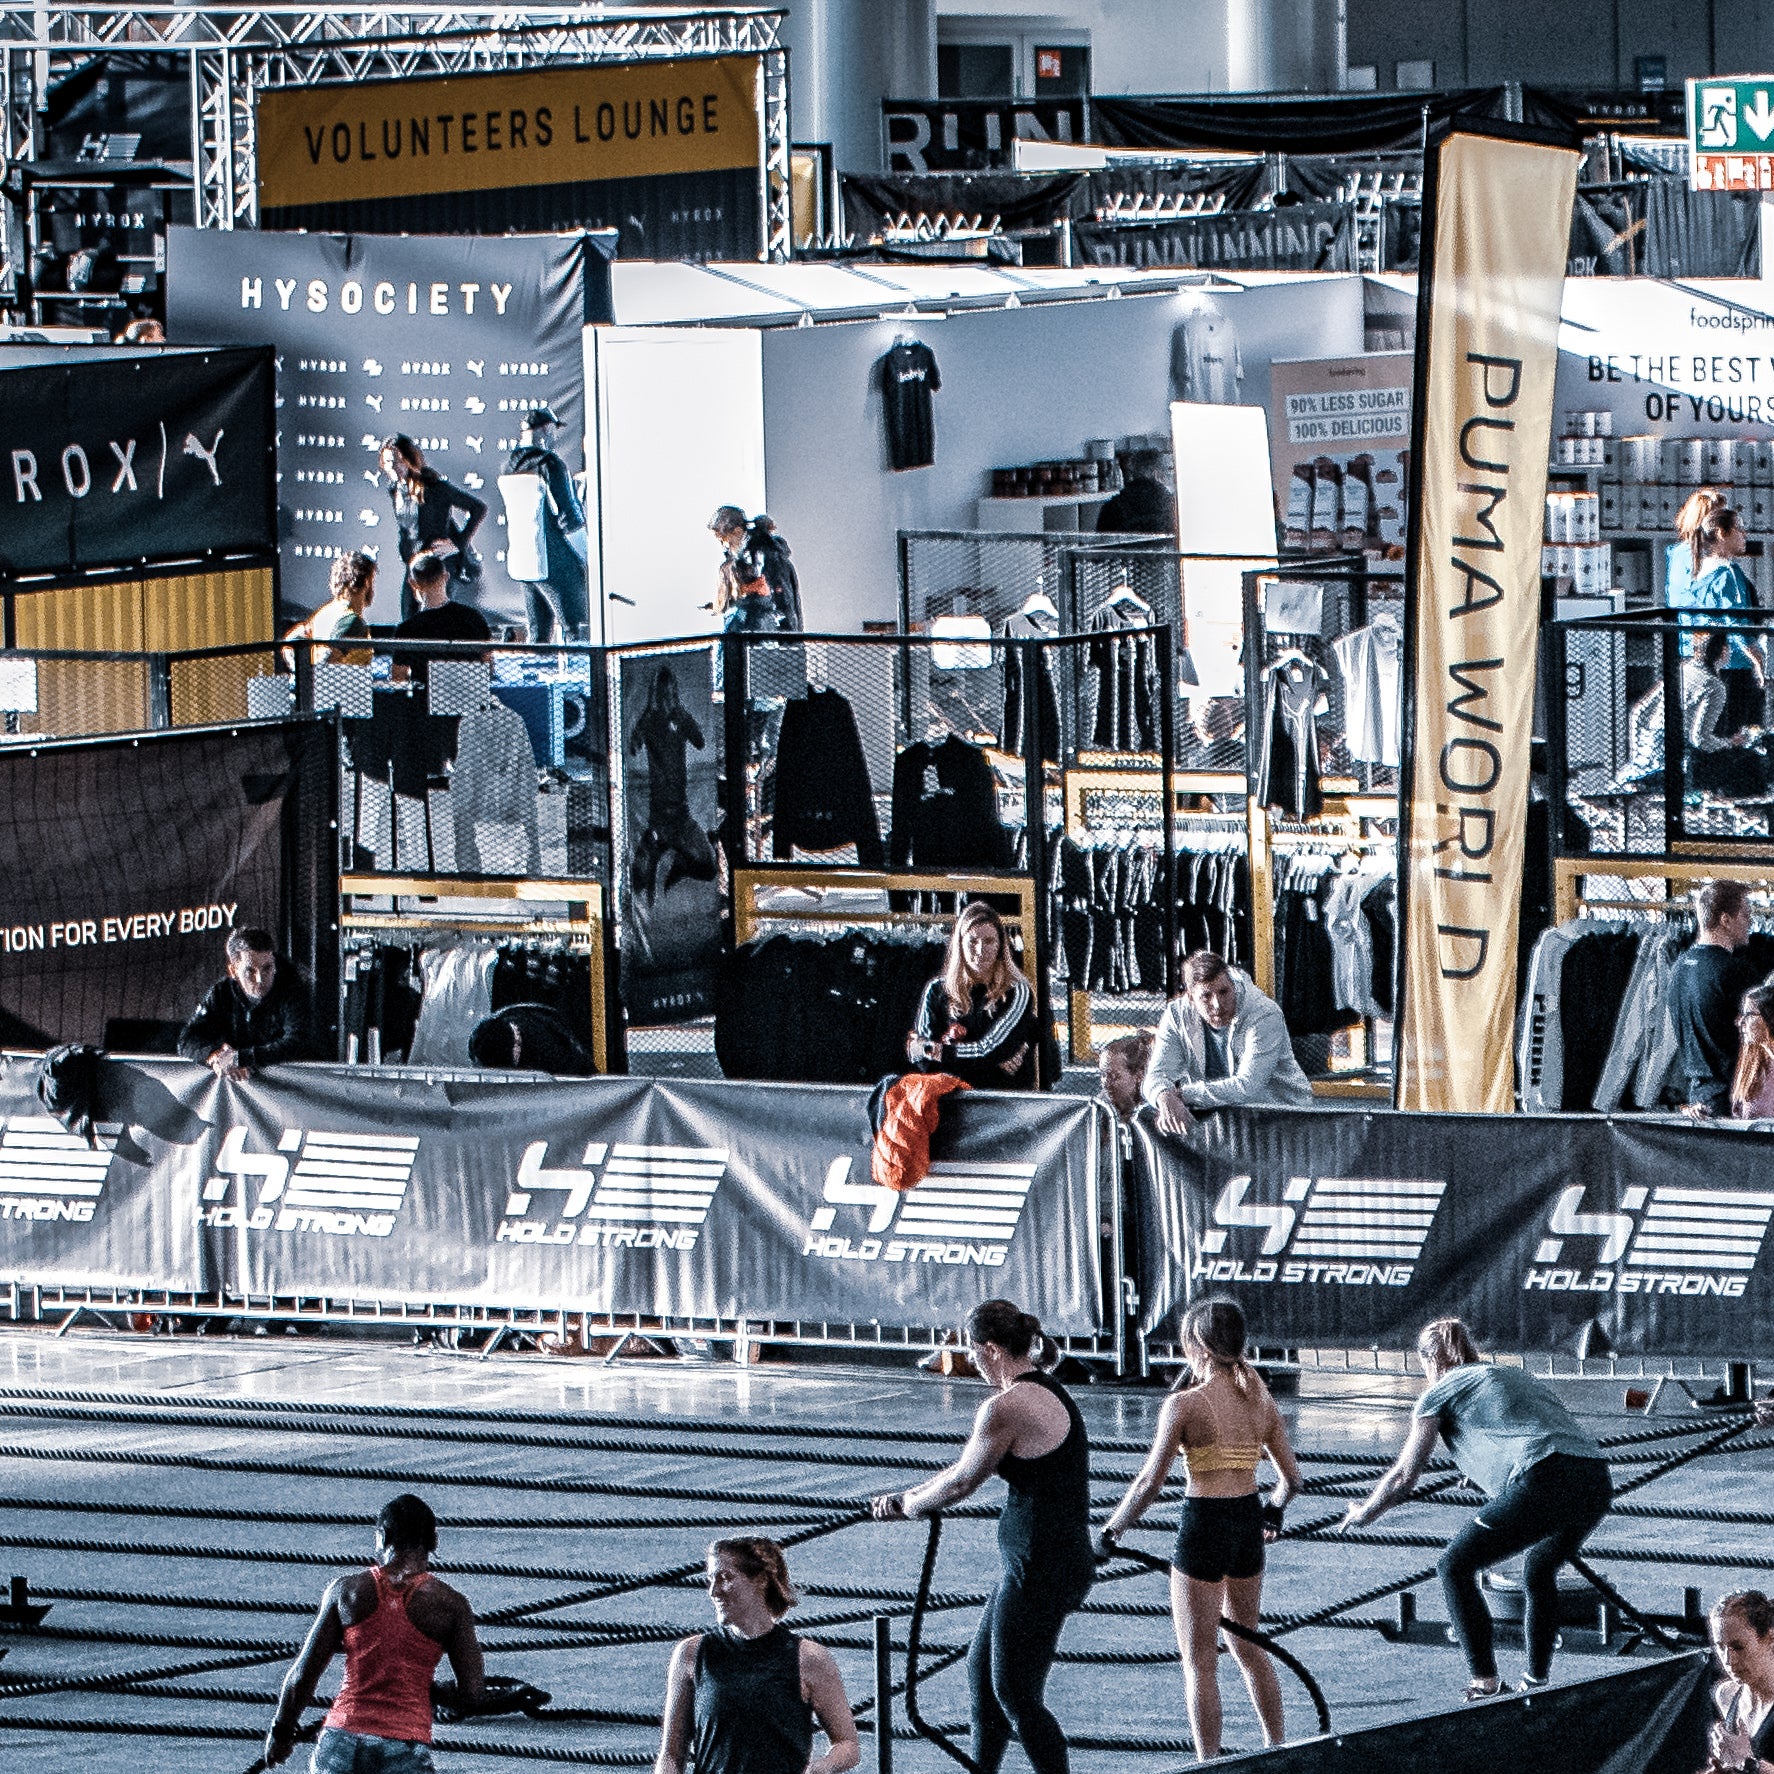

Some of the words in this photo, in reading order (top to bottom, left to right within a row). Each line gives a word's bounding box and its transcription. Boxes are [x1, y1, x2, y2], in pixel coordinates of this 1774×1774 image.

[304, 106, 554, 166] VOLUNTEERS
[574, 95, 720, 144] LOUNGE
[240, 276, 514, 315] HYSOCIETY
[1588, 354, 1625, 384] BE
[1630, 356, 1683, 384] THE
[1693, 356, 1758, 385] BEST
[1321, 394, 1355, 413] LESS
[1358, 391, 1404, 409] SUGAR
[1645, 391, 1683, 423] OF
[1331, 416, 1402, 436] DELICIOUS
[1449, 352, 1524, 623] PUMA
[1434, 655, 1508, 983] WORLD
[50, 920, 98, 948] FOR
[103, 912, 176, 942] EVERY
[179, 902, 239, 934] BODY
[272, 1208, 396, 1237] STRONG
[496, 1221, 587, 1246] HOLD
[587, 1224, 699, 1251] STRONG
[803, 1237, 885, 1261] HOLD
[886, 1239, 1007, 1267] STRONG
[1193, 1260, 1278, 1283] HOLD
[1281, 1261, 1414, 1287] STRONG
[1525, 1267, 1612, 1292] HOLD
[1615, 1275, 1748, 1299] STRONG
